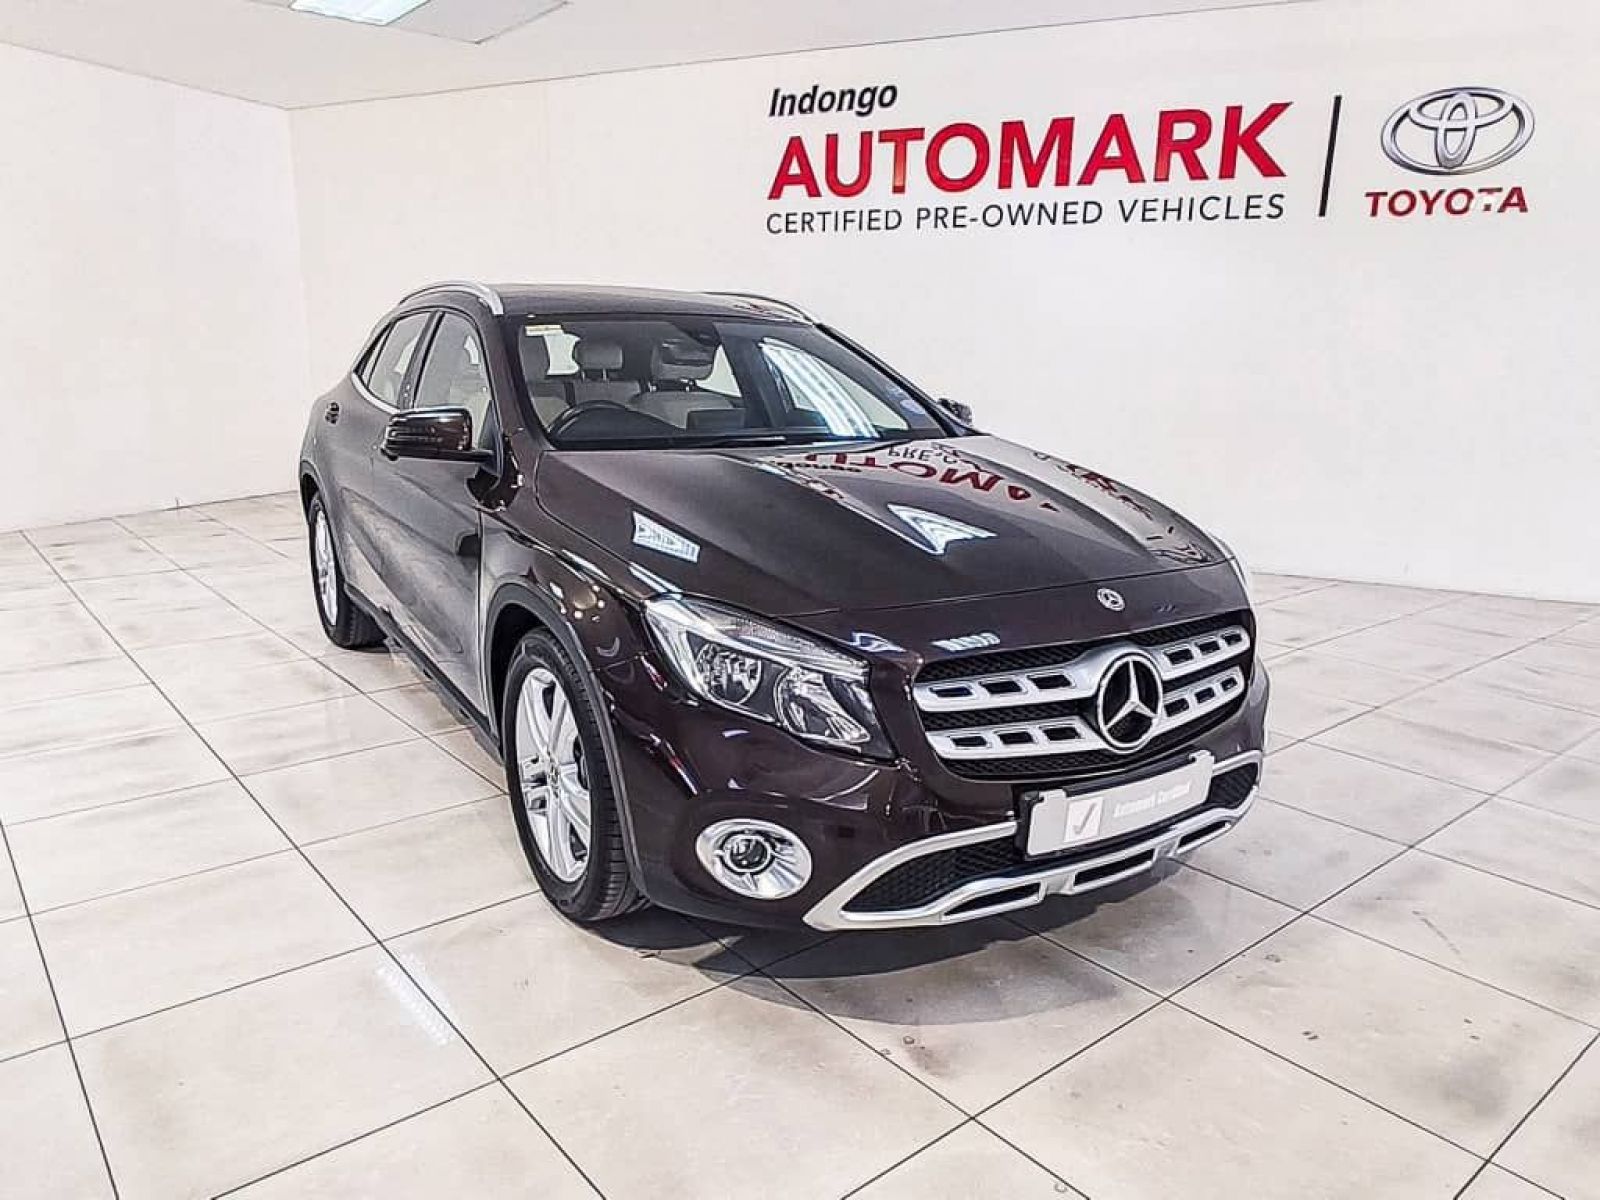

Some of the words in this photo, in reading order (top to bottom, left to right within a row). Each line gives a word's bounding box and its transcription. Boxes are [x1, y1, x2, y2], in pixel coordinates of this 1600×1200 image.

[768, 85, 898, 117] Indongo
[768, 102, 1293, 200] AUTOMARK
[766, 209, 903, 234] CERTIFIED
[917, 200, 1103, 229] PRE-OWNED
[1118, 193, 1285, 222] VEHICLES
[1365, 186, 1528, 217] TOYOTA
